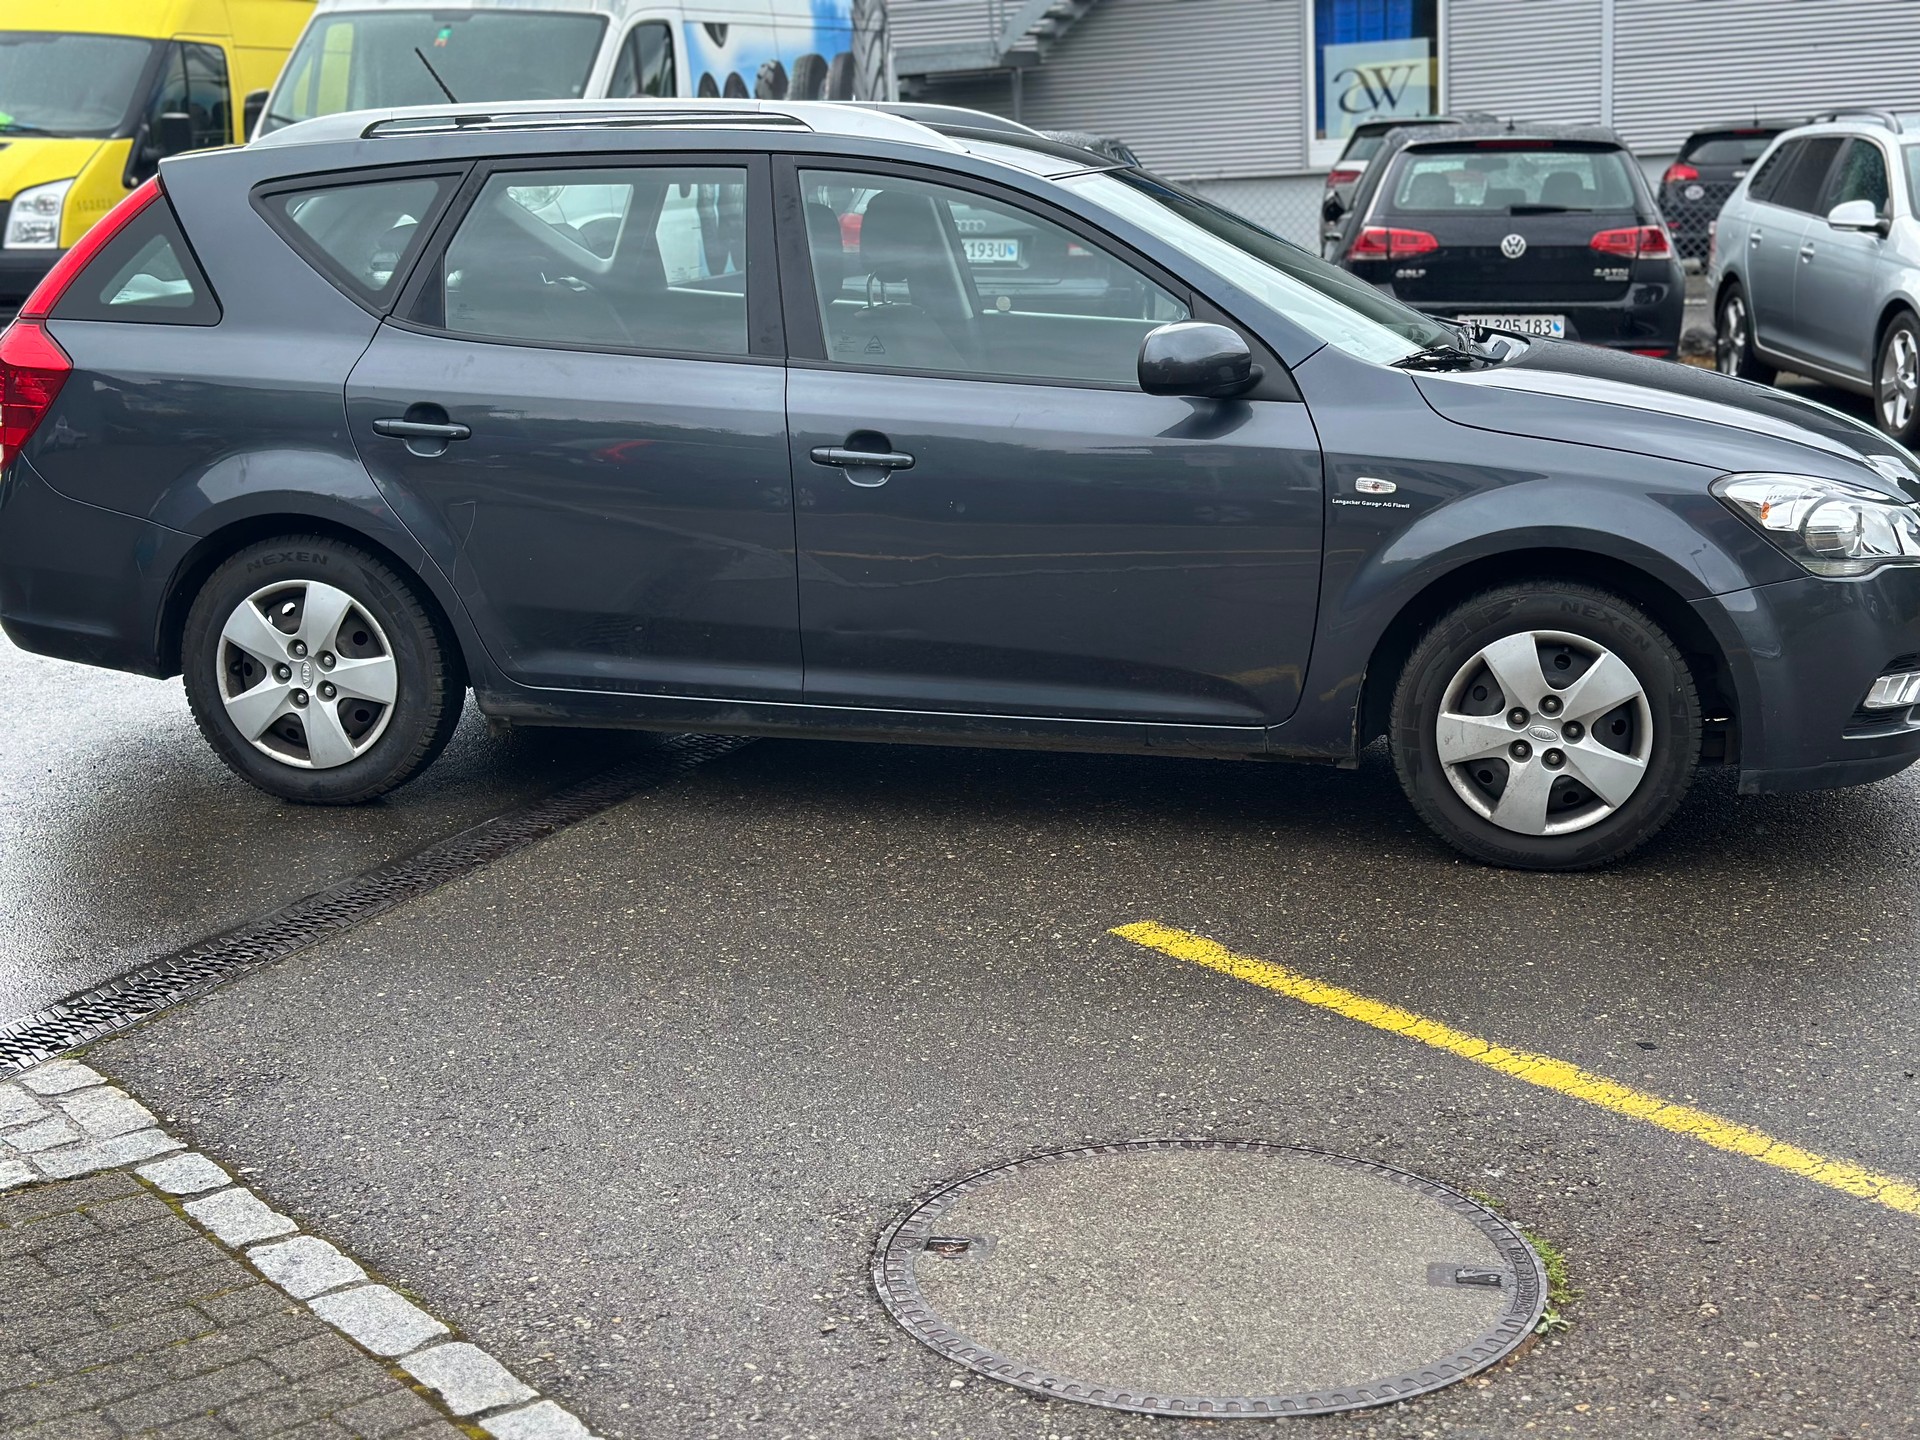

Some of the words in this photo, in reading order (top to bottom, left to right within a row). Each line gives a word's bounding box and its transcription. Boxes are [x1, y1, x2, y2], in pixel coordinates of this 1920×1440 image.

[1525, 319, 1551, 335] 183
[1361, 500, 1382, 508] Garage
[246, 551, 328, 573] NEXEN
[1560, 601, 1652, 651] NEXEN
